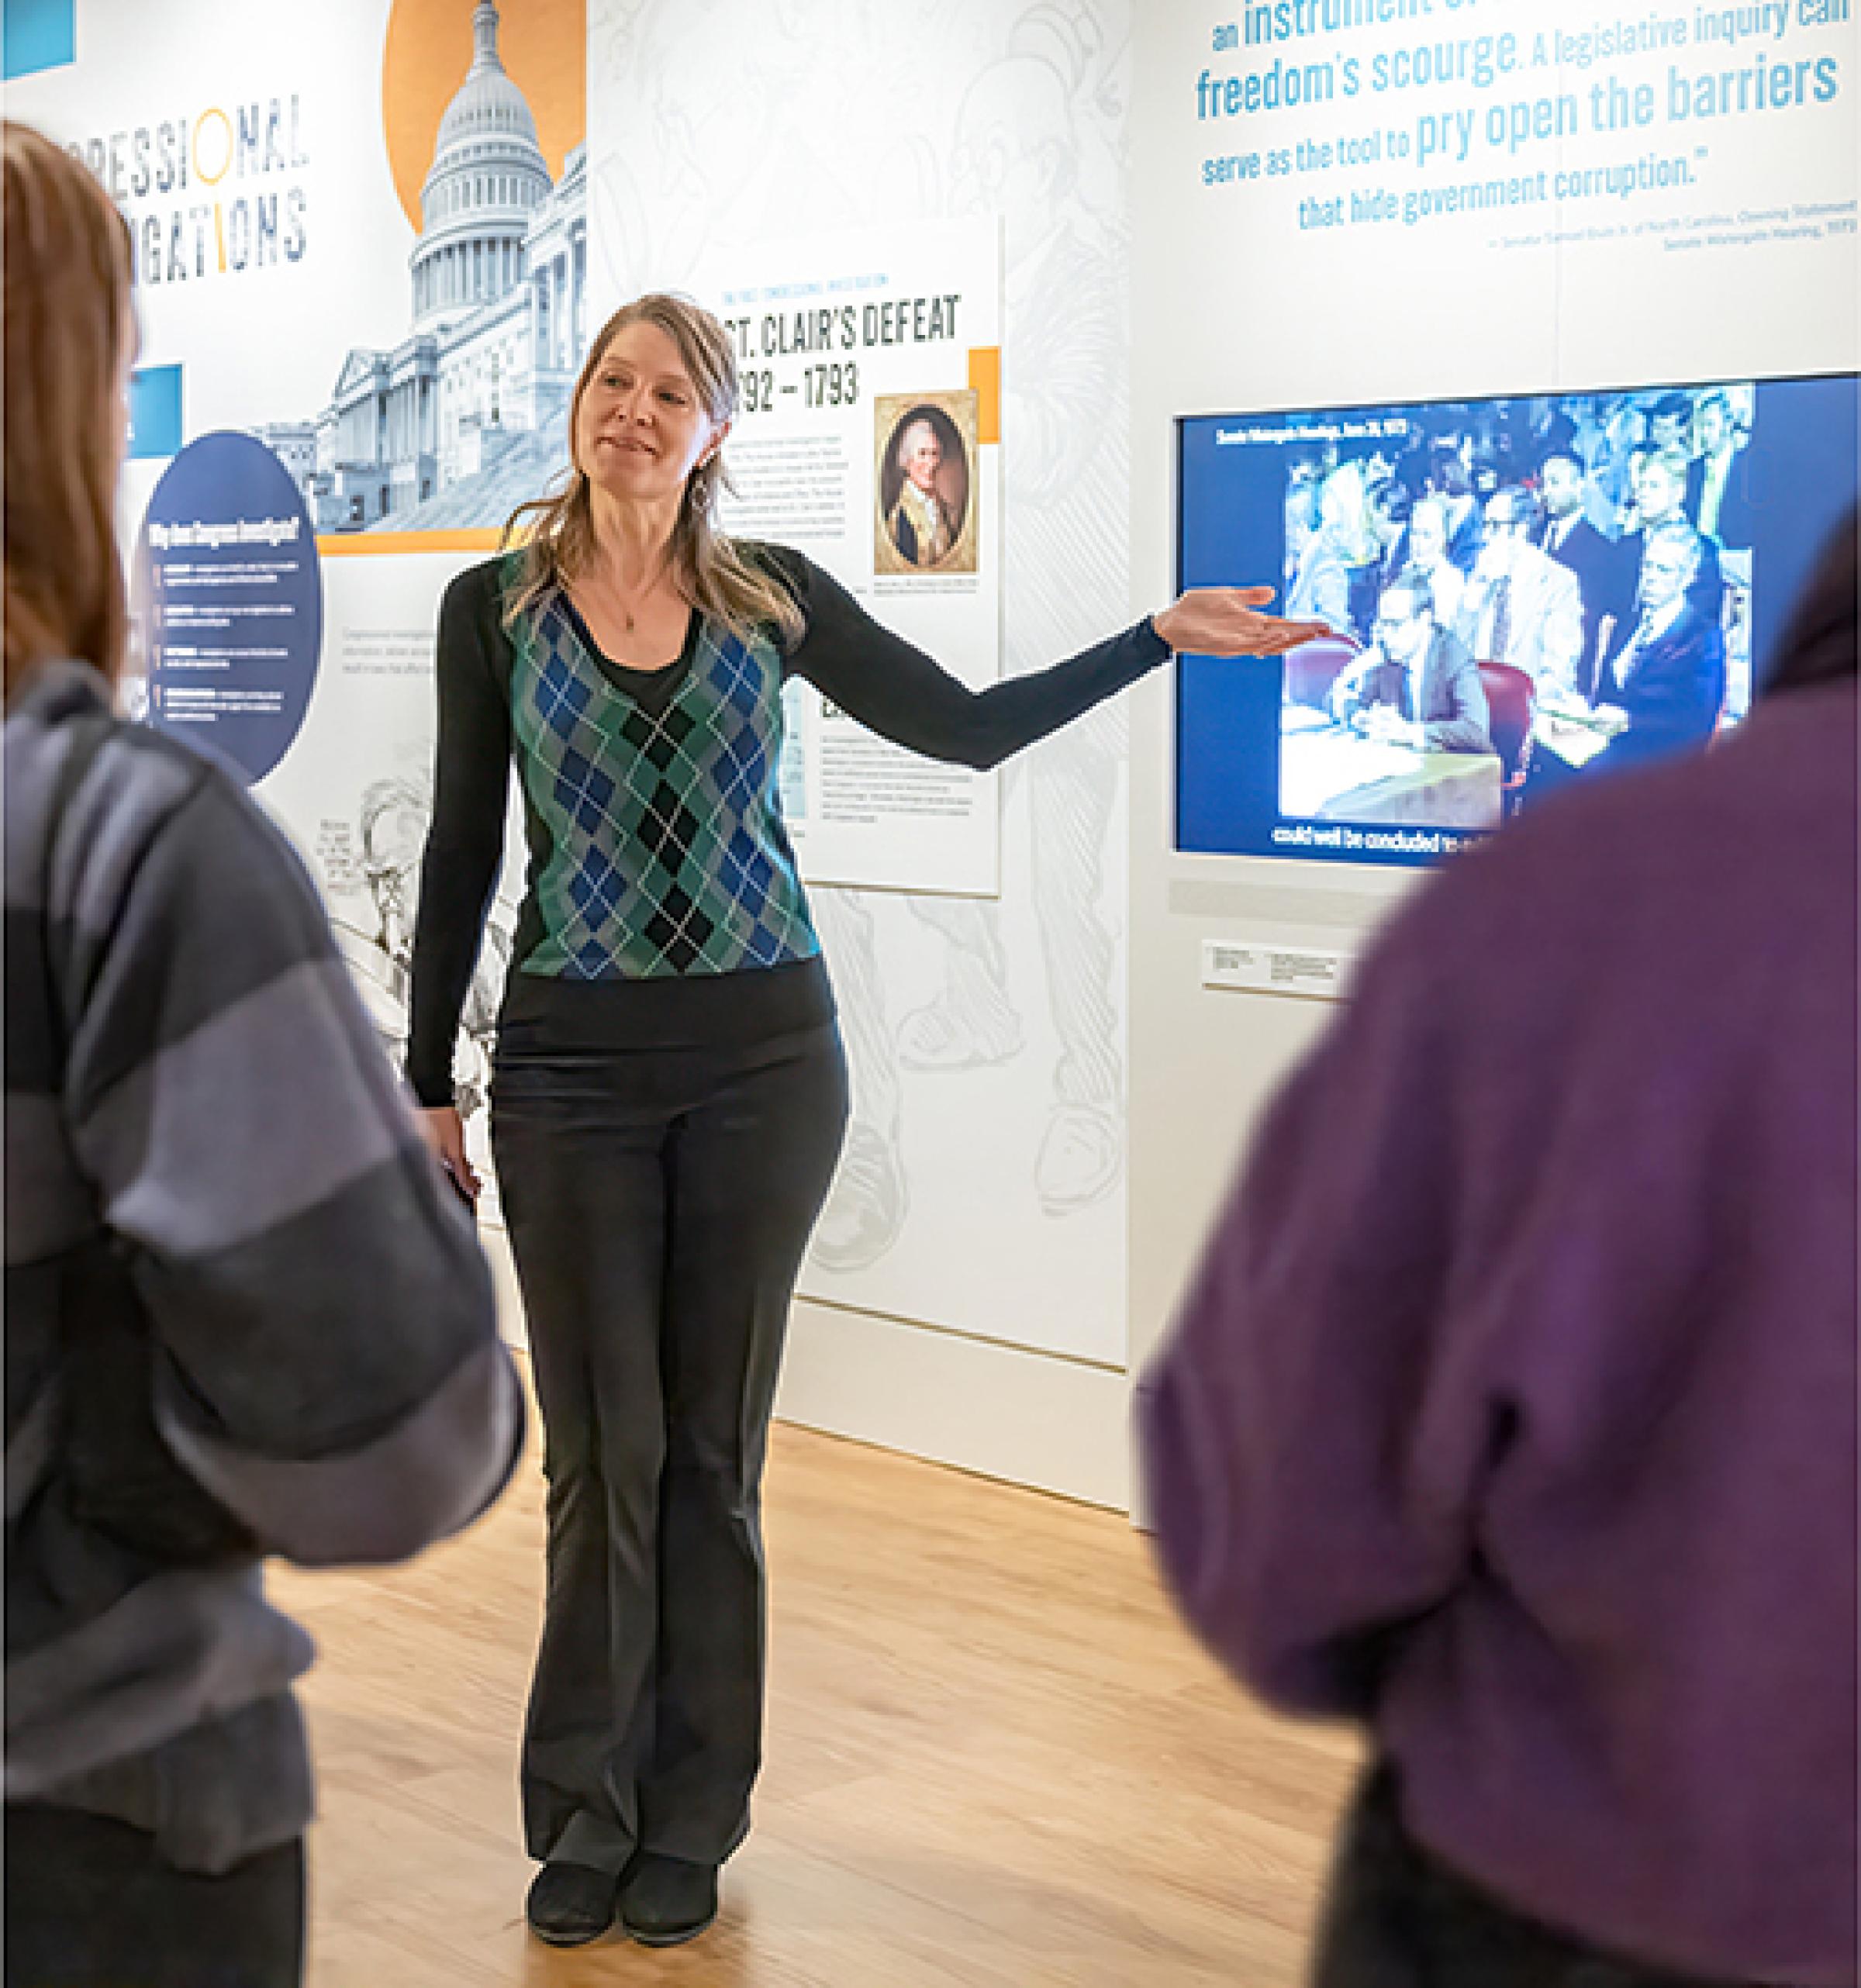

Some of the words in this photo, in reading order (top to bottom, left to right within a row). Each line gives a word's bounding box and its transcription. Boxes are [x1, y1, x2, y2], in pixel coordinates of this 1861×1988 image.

[1195, 52, 1360, 120] freedom's
[1372, 33, 1524, 91] scourge.
[1531, 32, 1549, 67] A
[1554, 11, 1687, 68] legislative
[1693, 2, 1788, 44] inquiry
[1213, 22, 1239, 51] an
[1202, 152, 1261, 186] serve
[1266, 148, 1292, 176] as
[1296, 137, 1333, 172] the
[1337, 127, 1381, 166] tool
[1386, 129, 1410, 160] to
[1417, 107, 1474, 168] pry
[1485, 93, 1578, 155] open
[1588, 75, 1654, 132] the
[1667, 51, 1838, 123] barriers
[1298, 195, 1345, 230] that
[1351, 188, 1400, 223] hide
[1403, 170, 1548, 226] government
[761, 305, 857, 357] CLAIR'S
[862, 294, 962, 347] DEFEAT
[804, 360, 860, 409] 1793
